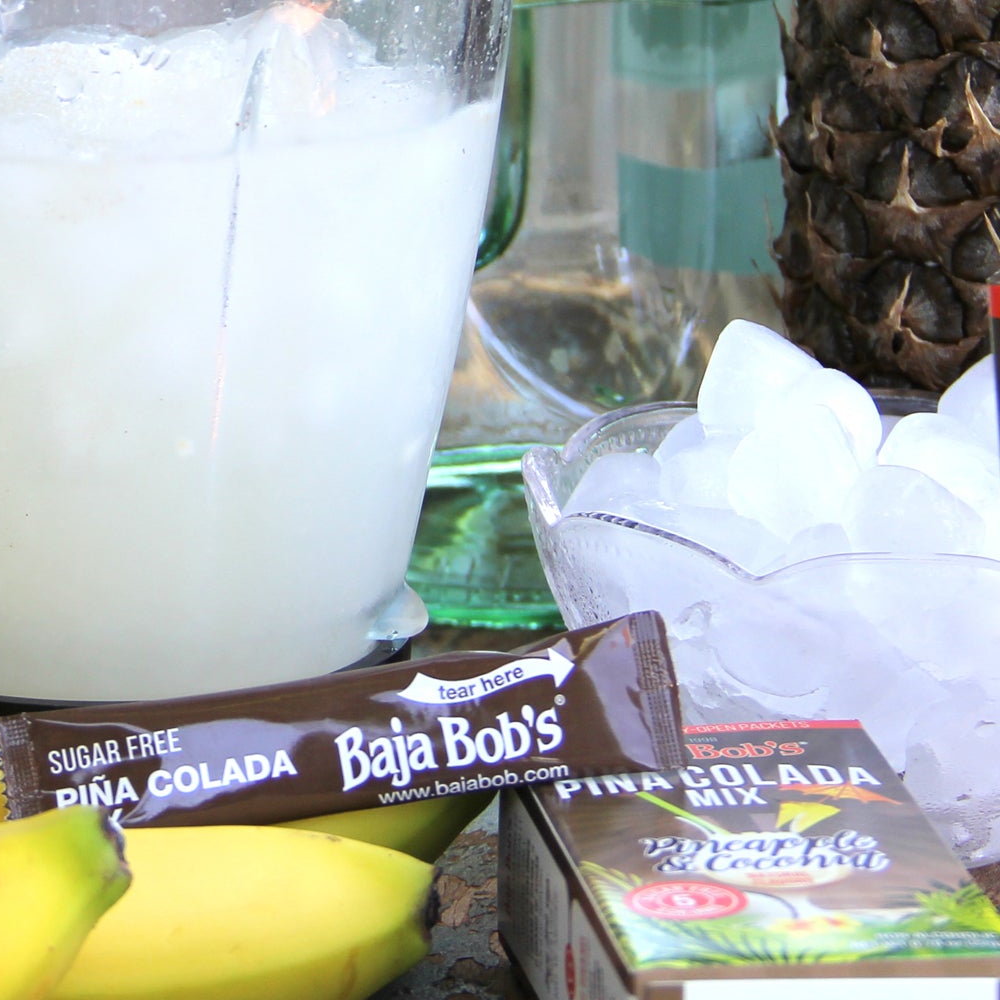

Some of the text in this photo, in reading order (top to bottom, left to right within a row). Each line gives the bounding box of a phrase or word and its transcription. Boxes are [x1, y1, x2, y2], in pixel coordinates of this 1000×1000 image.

[438, 666, 524, 700] tear here
[738, 720, 810, 731] PACKETS
[48, 728, 182, 774] SUGAR FREE
[334, 704, 564, 792] Baja Bob's
[684, 740, 806, 760] Bob's
[56, 750, 298, 809] PIÑA COLADA
[378, 764, 570, 805] www.bajabob.com
[678, 763, 882, 788] COLADA
[685, 787, 768, 808] MIX
[641, 828, 879, 857] Pineapple
